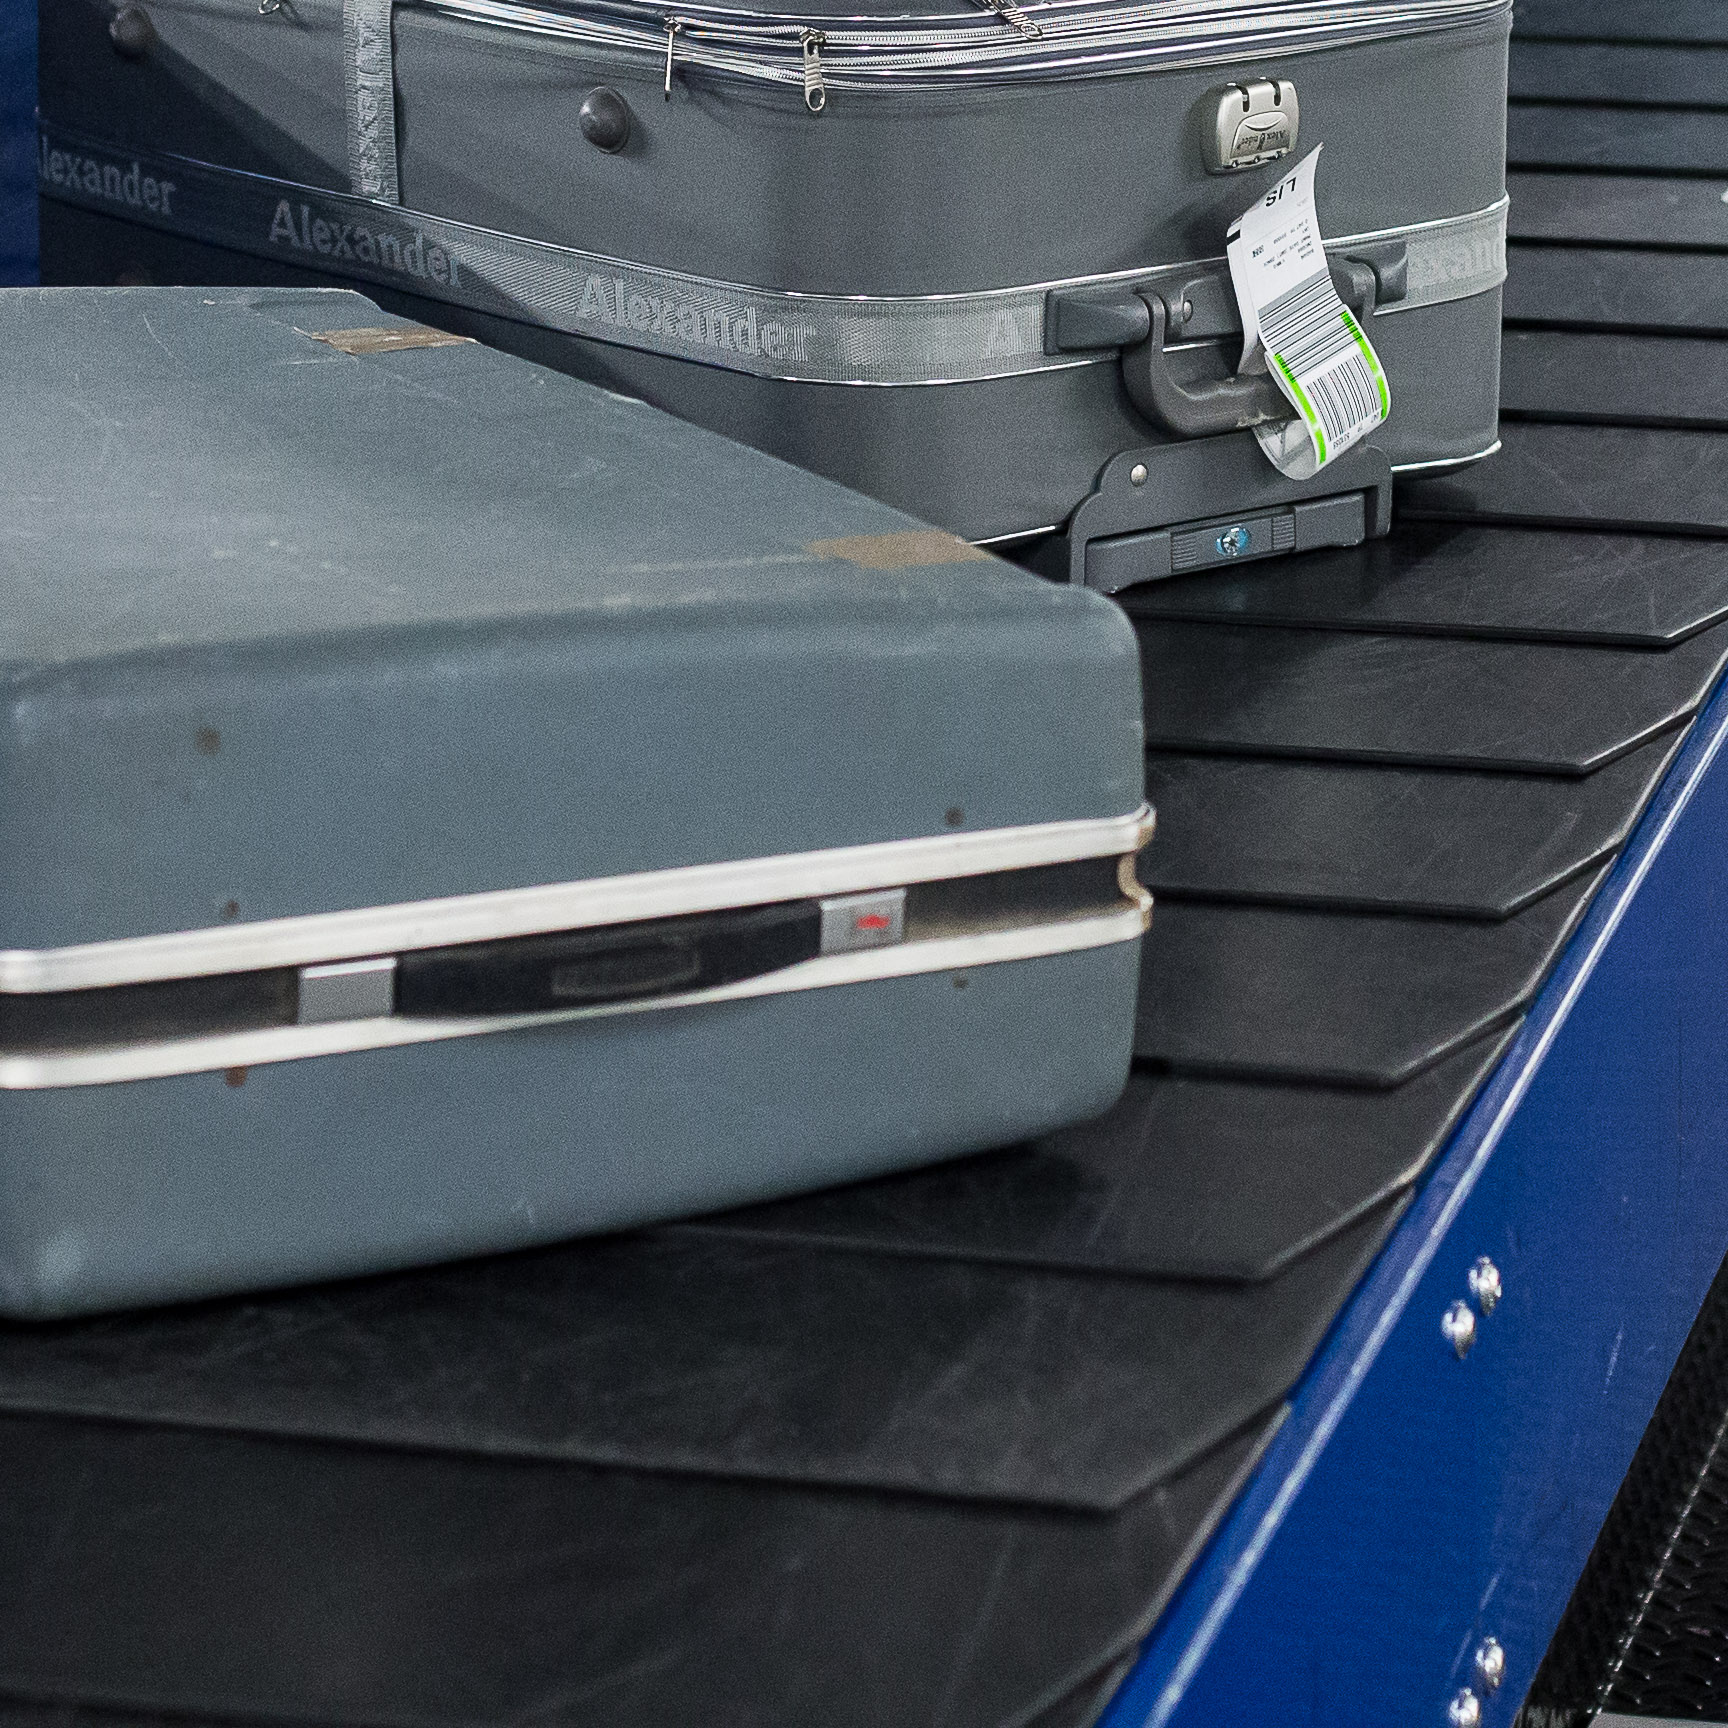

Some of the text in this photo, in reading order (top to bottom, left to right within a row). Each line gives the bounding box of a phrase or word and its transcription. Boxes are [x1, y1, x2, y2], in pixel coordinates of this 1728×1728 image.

[39, 135, 176, 215] lexander
[1265, 177, 1296, 207] LIS
[270, 200, 462, 287] Alexander
[576, 273, 816, 363] Alexander
